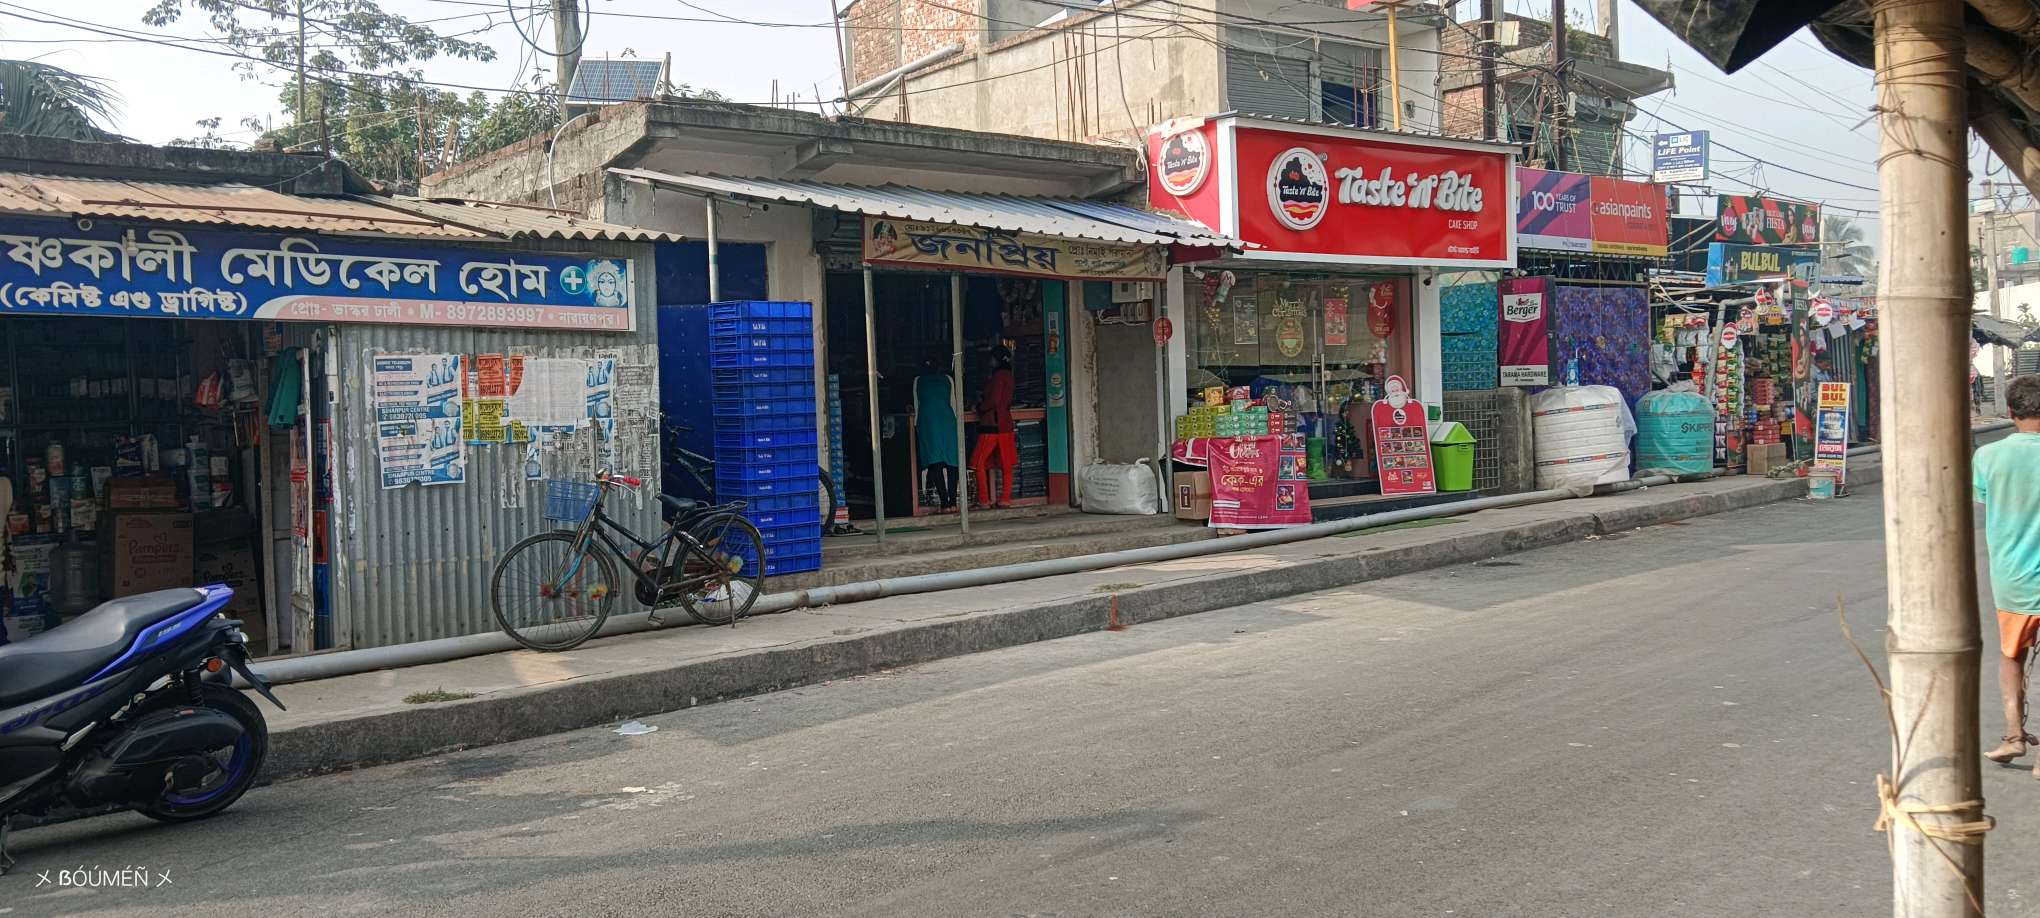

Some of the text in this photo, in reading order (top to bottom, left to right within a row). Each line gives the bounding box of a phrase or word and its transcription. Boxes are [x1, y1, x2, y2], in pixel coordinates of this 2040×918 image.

[1658, 146, 1701, 156] LIFE Point
[1334, 166, 1406, 207] Taste
[1434, 170, 1483, 213] Bite
[1531, 191, 1555, 212] 100
[1555, 201, 1577, 214] TRUST
[1599, 198, 1653, 224] asianpaints
[1448, 219, 1479, 231] CAKE SHOP
[1740, 251, 1780, 272] BULBUL
[221, 238, 440, 294] মেডিকেল
[460, 258, 549, 302] হোম
[447, 305, 545, 323] 8972893997
[1506, 305, 1538, 318] Berger
[1822, 383, 1846, 391] BUL
[1822, 393, 1845, 401] BUL
